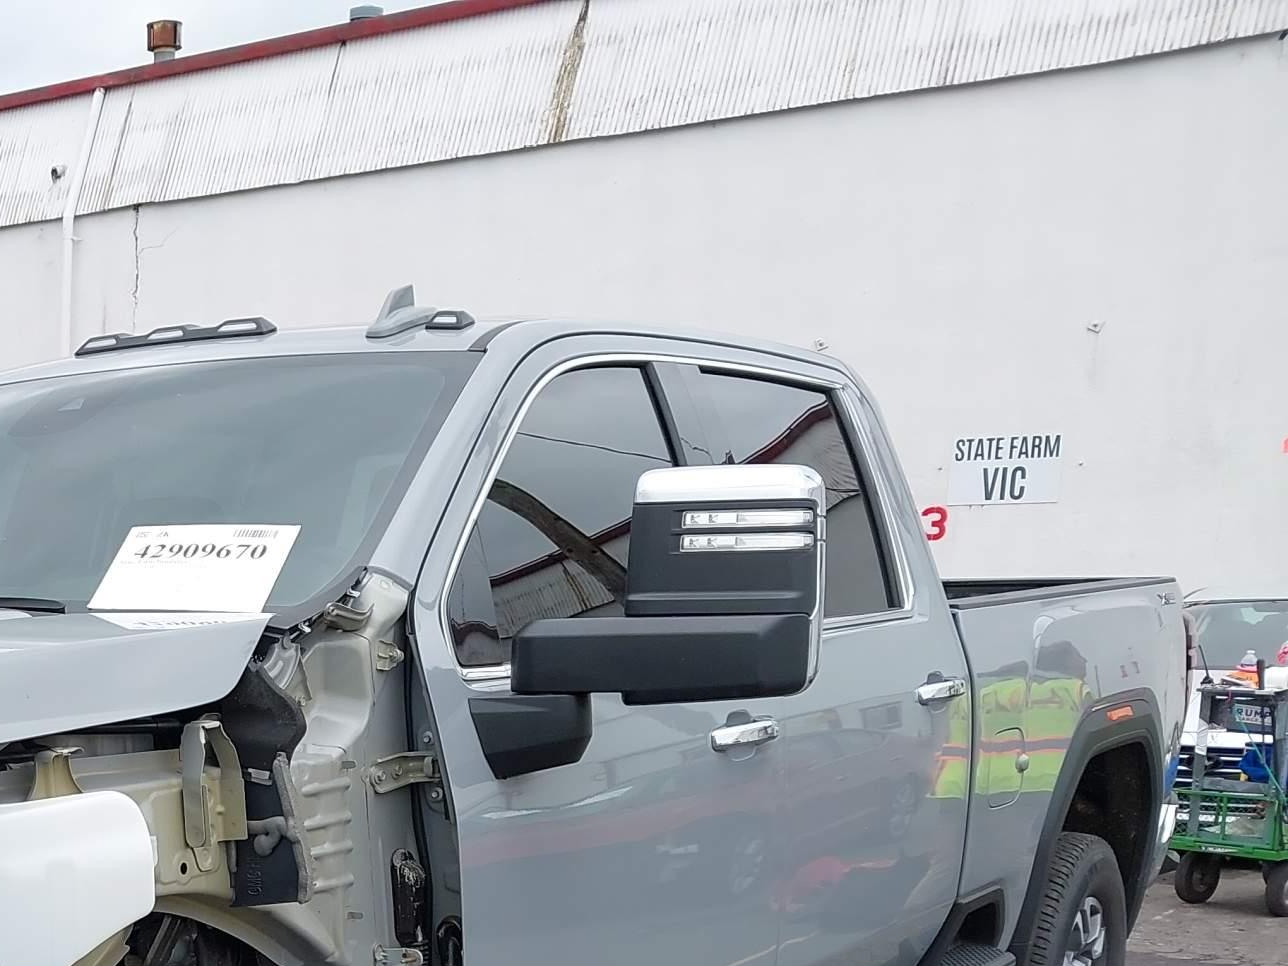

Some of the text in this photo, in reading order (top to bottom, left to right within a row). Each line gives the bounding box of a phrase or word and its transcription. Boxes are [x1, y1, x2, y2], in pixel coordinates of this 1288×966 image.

[954, 434, 1061, 462] STATE FARM
[983, 466, 1027, 501] VIC
[921, 506, 948, 541] 3
[134, 542, 268, 560] 42909670
